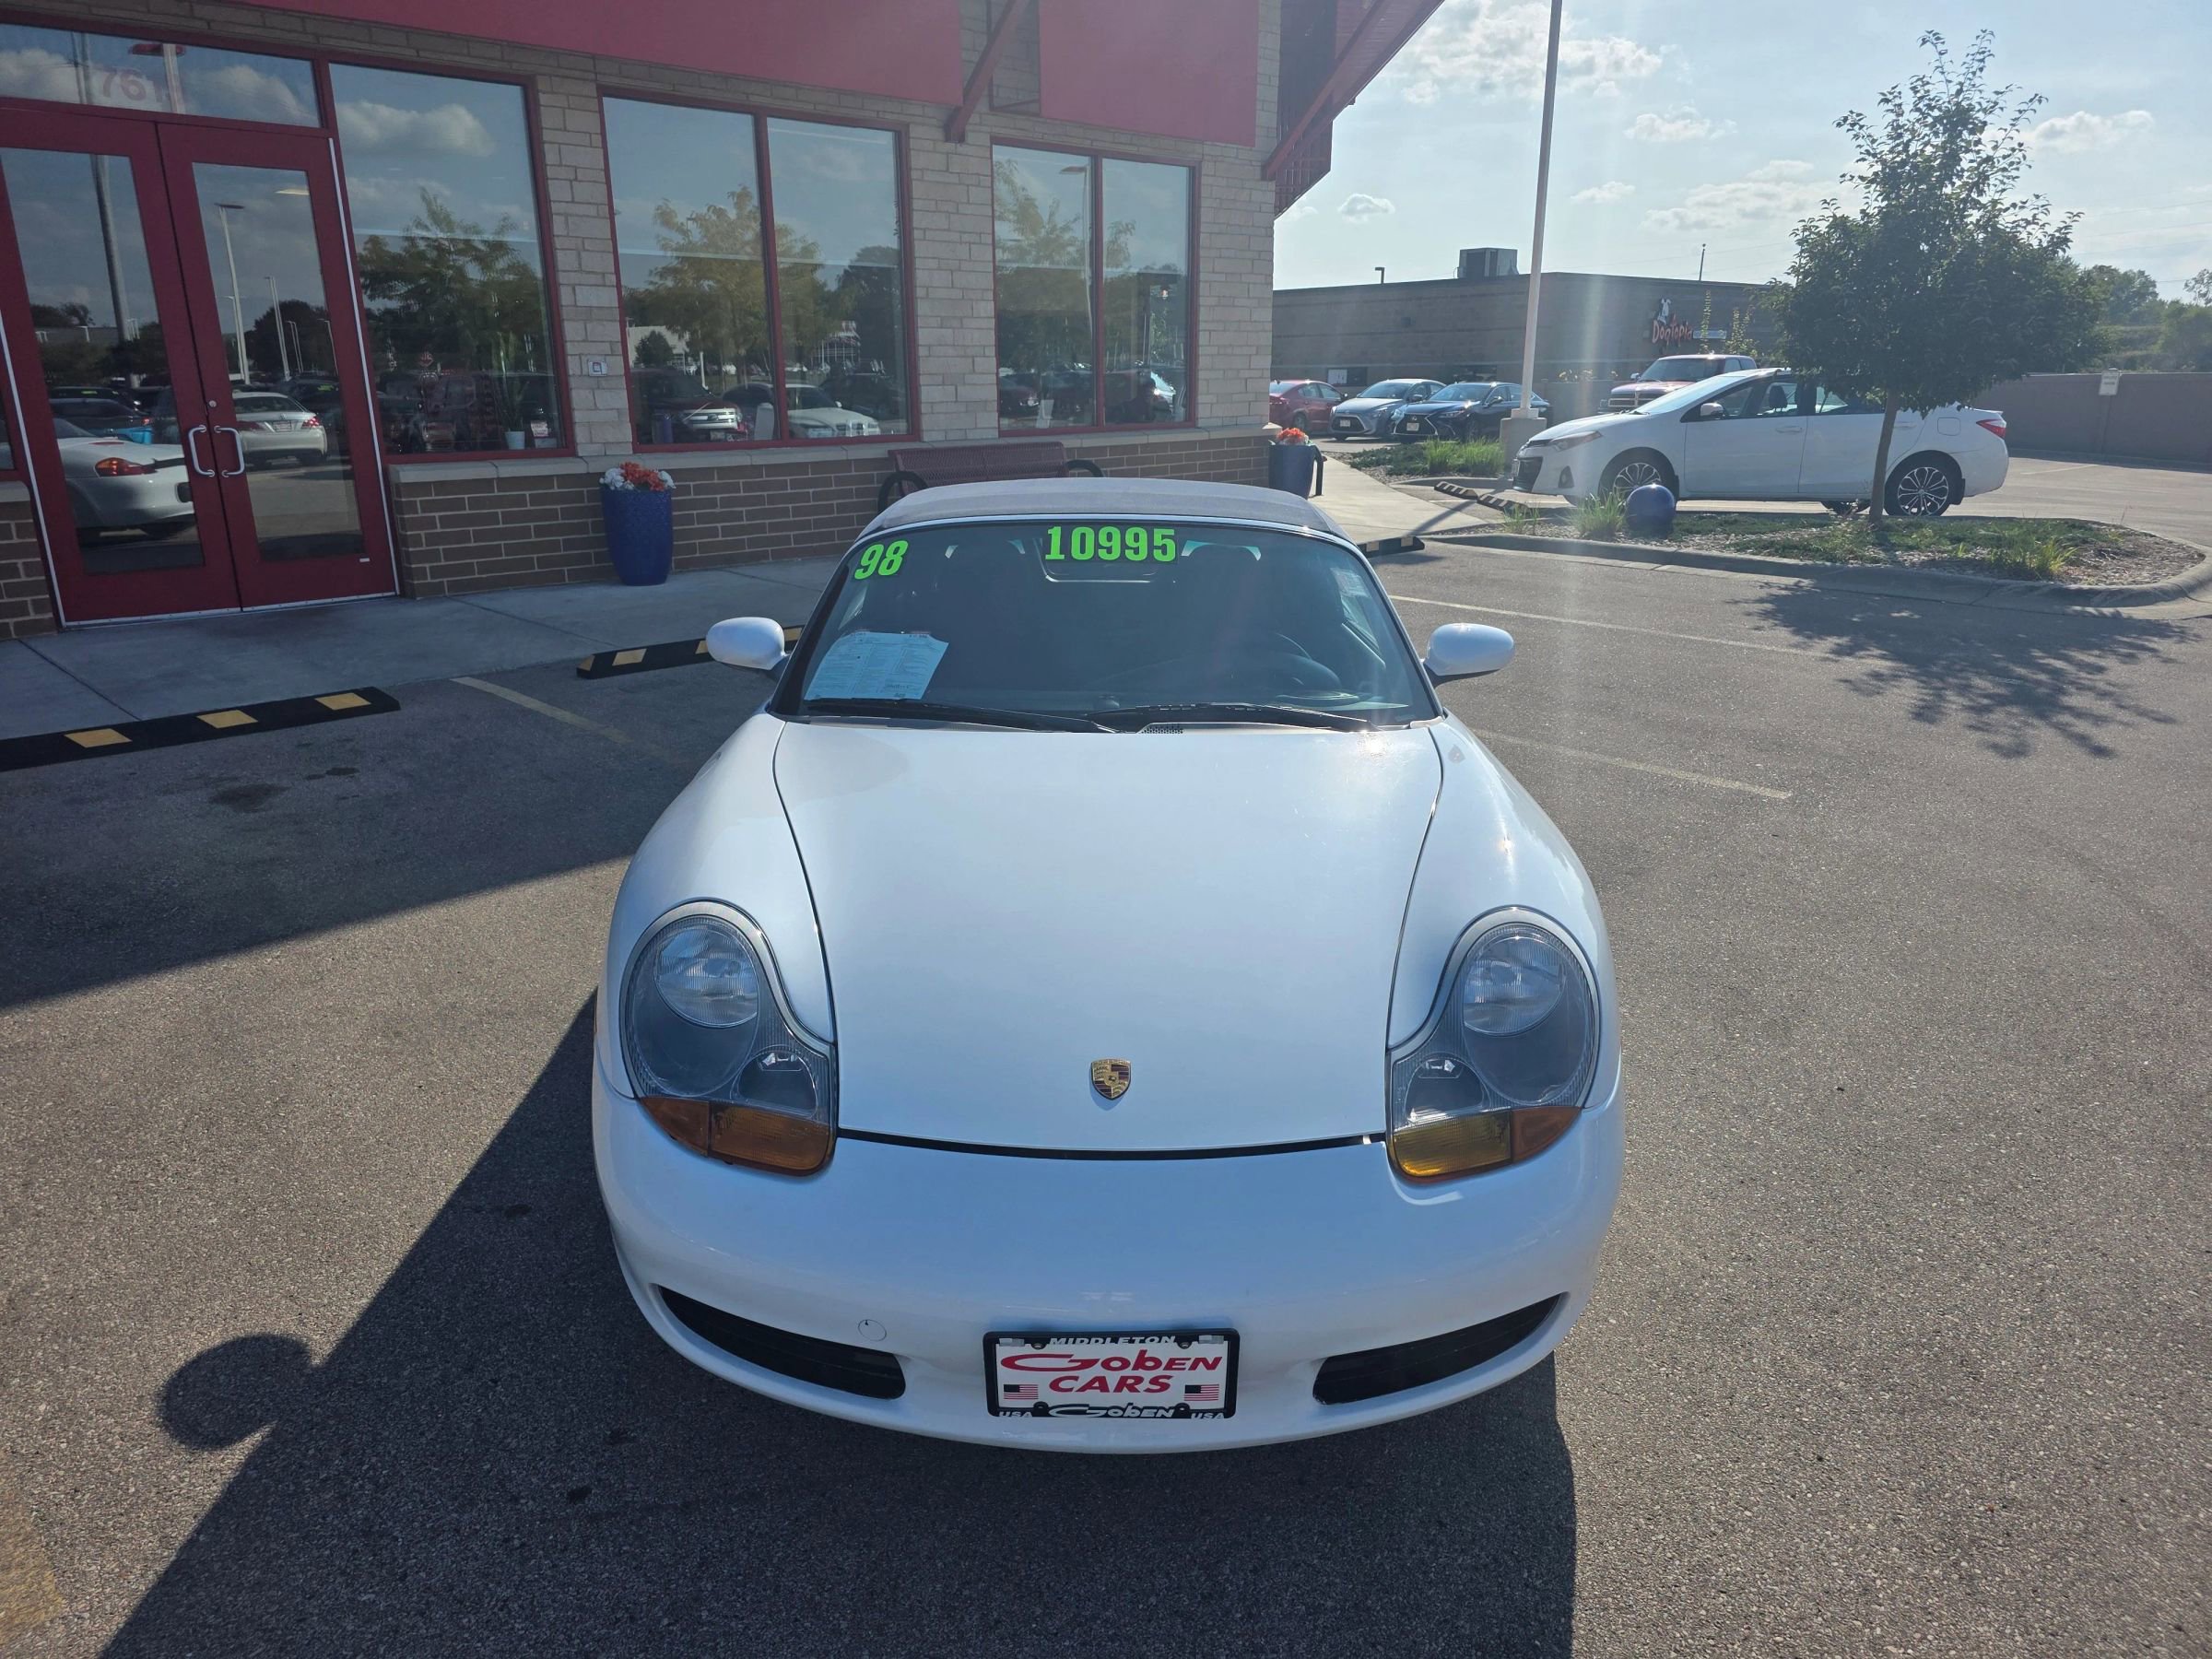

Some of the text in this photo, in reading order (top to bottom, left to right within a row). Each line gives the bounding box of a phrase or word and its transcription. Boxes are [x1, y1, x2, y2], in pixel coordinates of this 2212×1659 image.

[1045, 525, 1176, 562] 10995
[854, 540, 909, 580] 98
[1049, 1335, 1176, 1346] MIDDLETON
[1049, 1375, 1174, 1394] CARS
